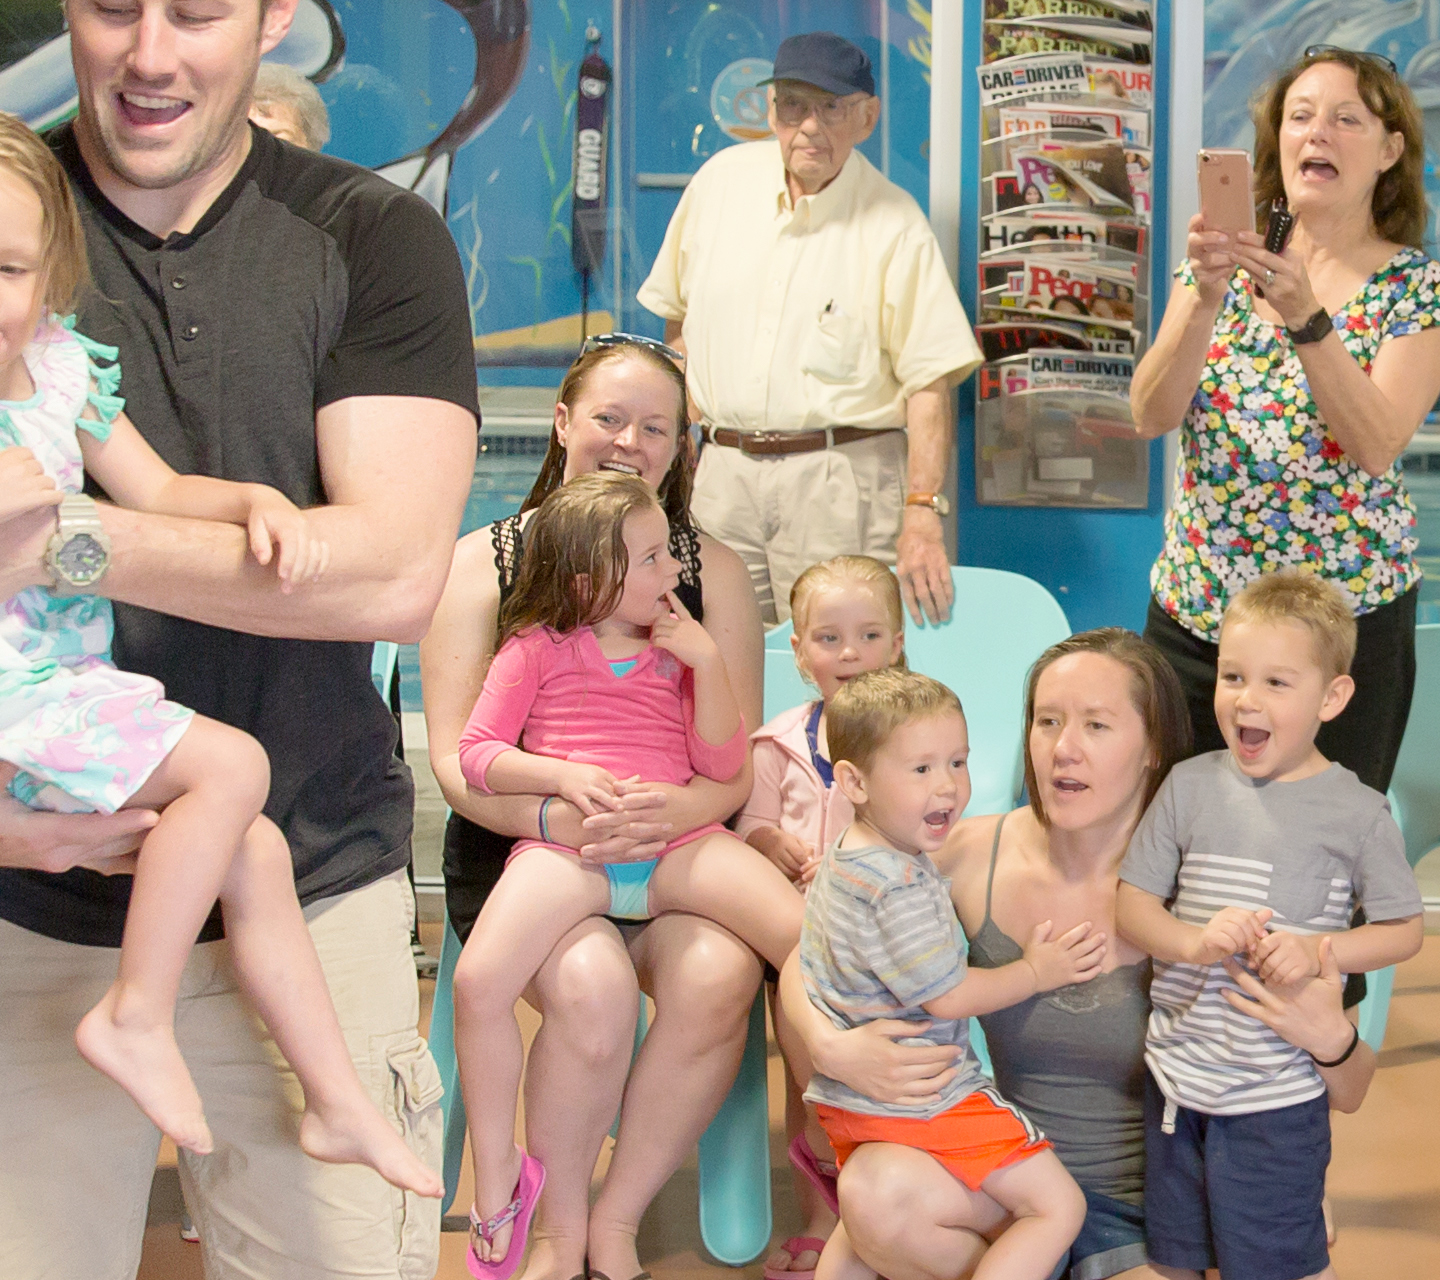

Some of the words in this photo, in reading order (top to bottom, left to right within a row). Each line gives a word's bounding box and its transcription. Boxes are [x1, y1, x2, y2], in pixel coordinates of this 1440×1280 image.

[981, 70, 1014, 90] CAR
[1026, 64, 1085, 86] DRIVER
[576, 128, 601, 200] GUARD
[983, 225, 1096, 252] Helth
[1031, 357, 1062, 373] CAR
